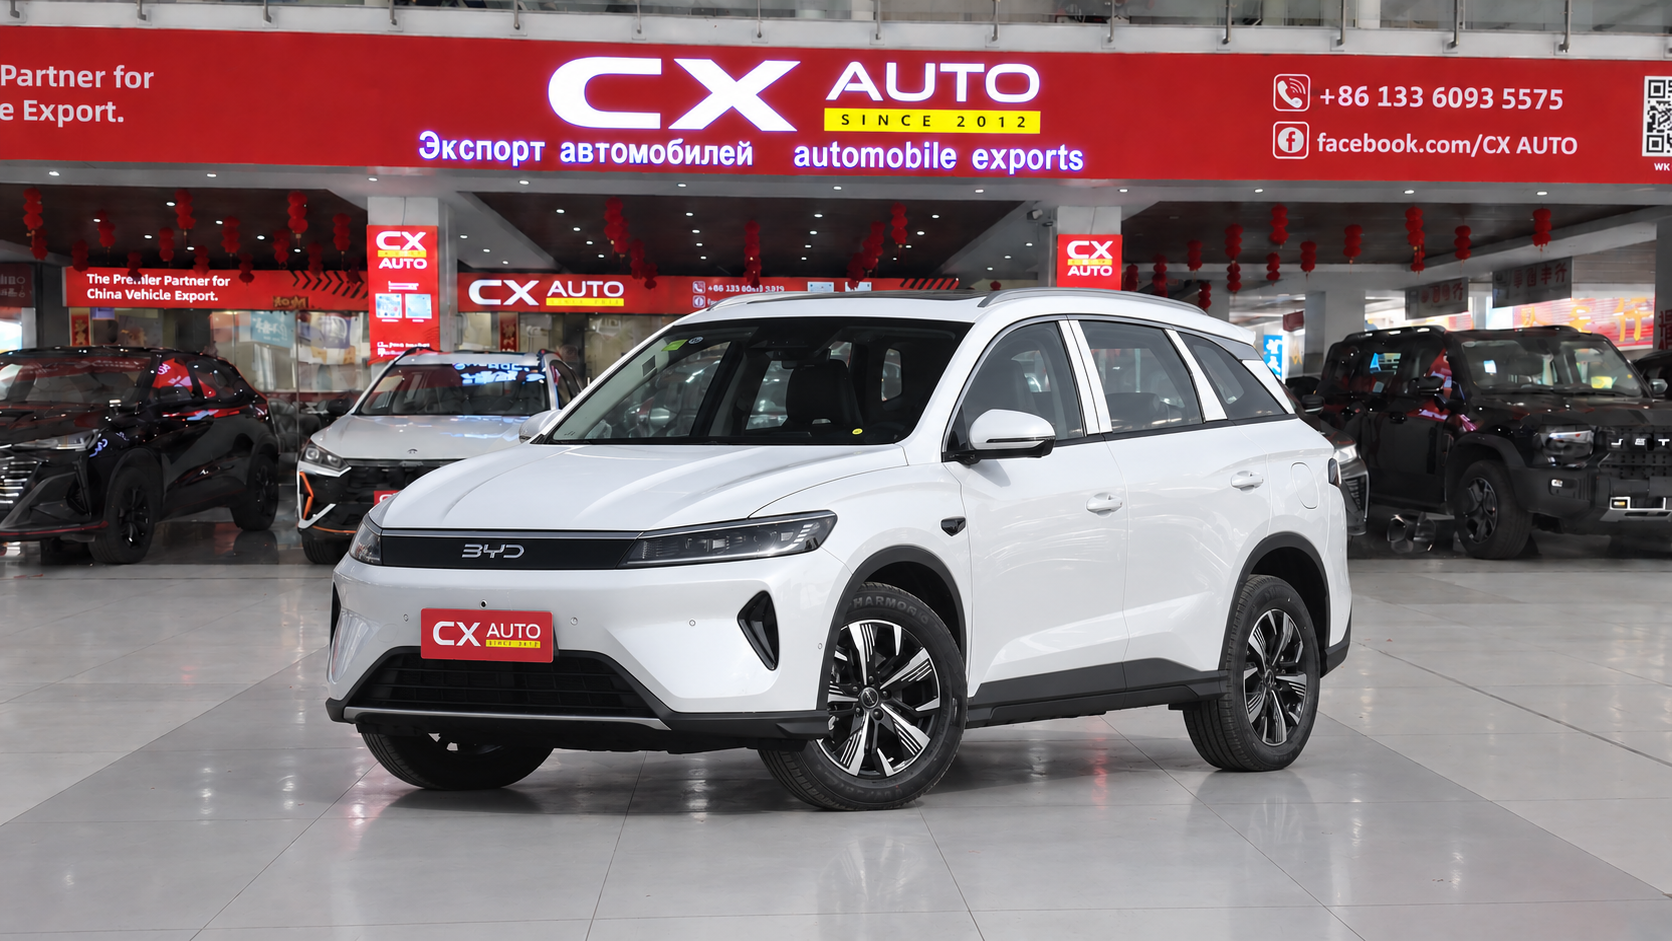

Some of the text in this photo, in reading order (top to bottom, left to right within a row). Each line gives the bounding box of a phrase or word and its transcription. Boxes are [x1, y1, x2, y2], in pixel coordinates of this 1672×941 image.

[1, 65, 155, 89] Partner for
[548, 56, 1040, 132] CX AUTO
[1319, 86, 1563, 110] +86 133 6093 5575
[23, 100, 124, 127] Export.
[841, 114, 1026, 128] SINCE 2012
[419, 131, 753, 167] Экспорт автомобилей
[1317, 133, 1578, 157] facebook.com/CX AUTO
[794, 141, 1084, 175] automobile exports
[376, 231, 426, 250] CX
[1067, 240, 1113, 260] CX
[379, 258, 427, 270] AUTO
[1067, 265, 1112, 277] AUTO
[87, 274, 111, 285] The
[164, 275, 210, 287] Partner
[212, 276, 231, 287] for
[87, 288, 219, 304] China Vehicle Export.
[468, 280, 625, 306] CX AUTO
[462, 543, 525, 559] BYD
[433, 621, 541, 647] CX AUTO
